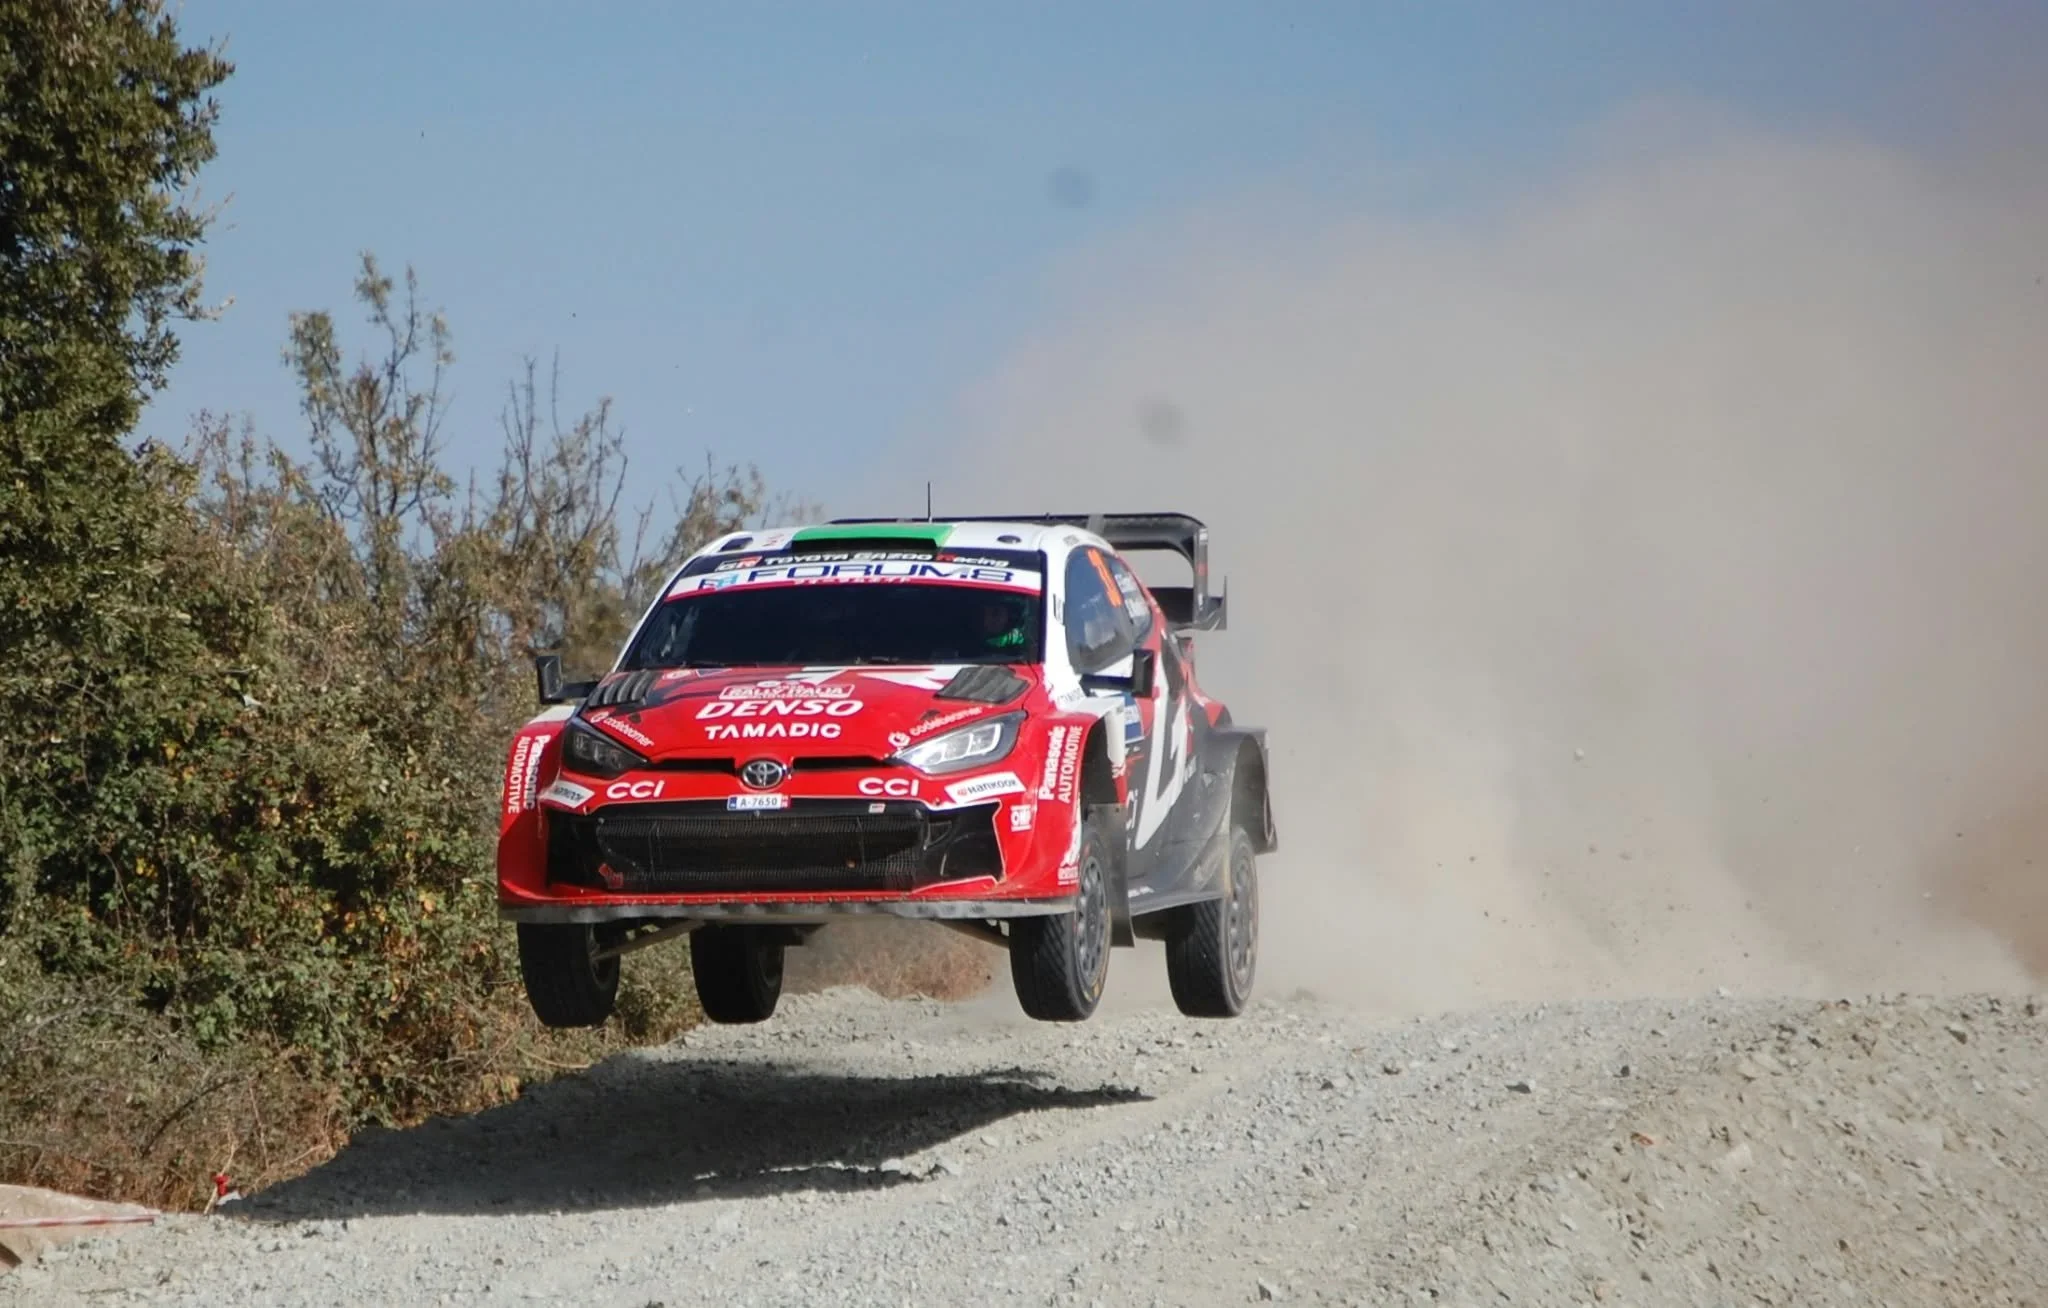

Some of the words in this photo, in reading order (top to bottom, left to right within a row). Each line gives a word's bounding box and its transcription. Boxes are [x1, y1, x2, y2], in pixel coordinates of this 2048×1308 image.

[764, 553, 849, 565] TOYOTA
[853, 552, 933, 561] GAZOO
[936, 553, 1009, 568] Racing
[748, 564, 1014, 583] FORUM8
[695, 699, 864, 720] DENSO
[704, 723, 841, 740] TAMADIC
[1038, 725, 1066, 801] Panasonic
[1058, 725, 1083, 804] AUTOMOTIVE
[507, 736, 531, 815] AUTOMOTIVE
[606, 780, 665, 799] CCI
[858, 777, 920, 797] CCI
[740, 797, 778, 807] A-7650
